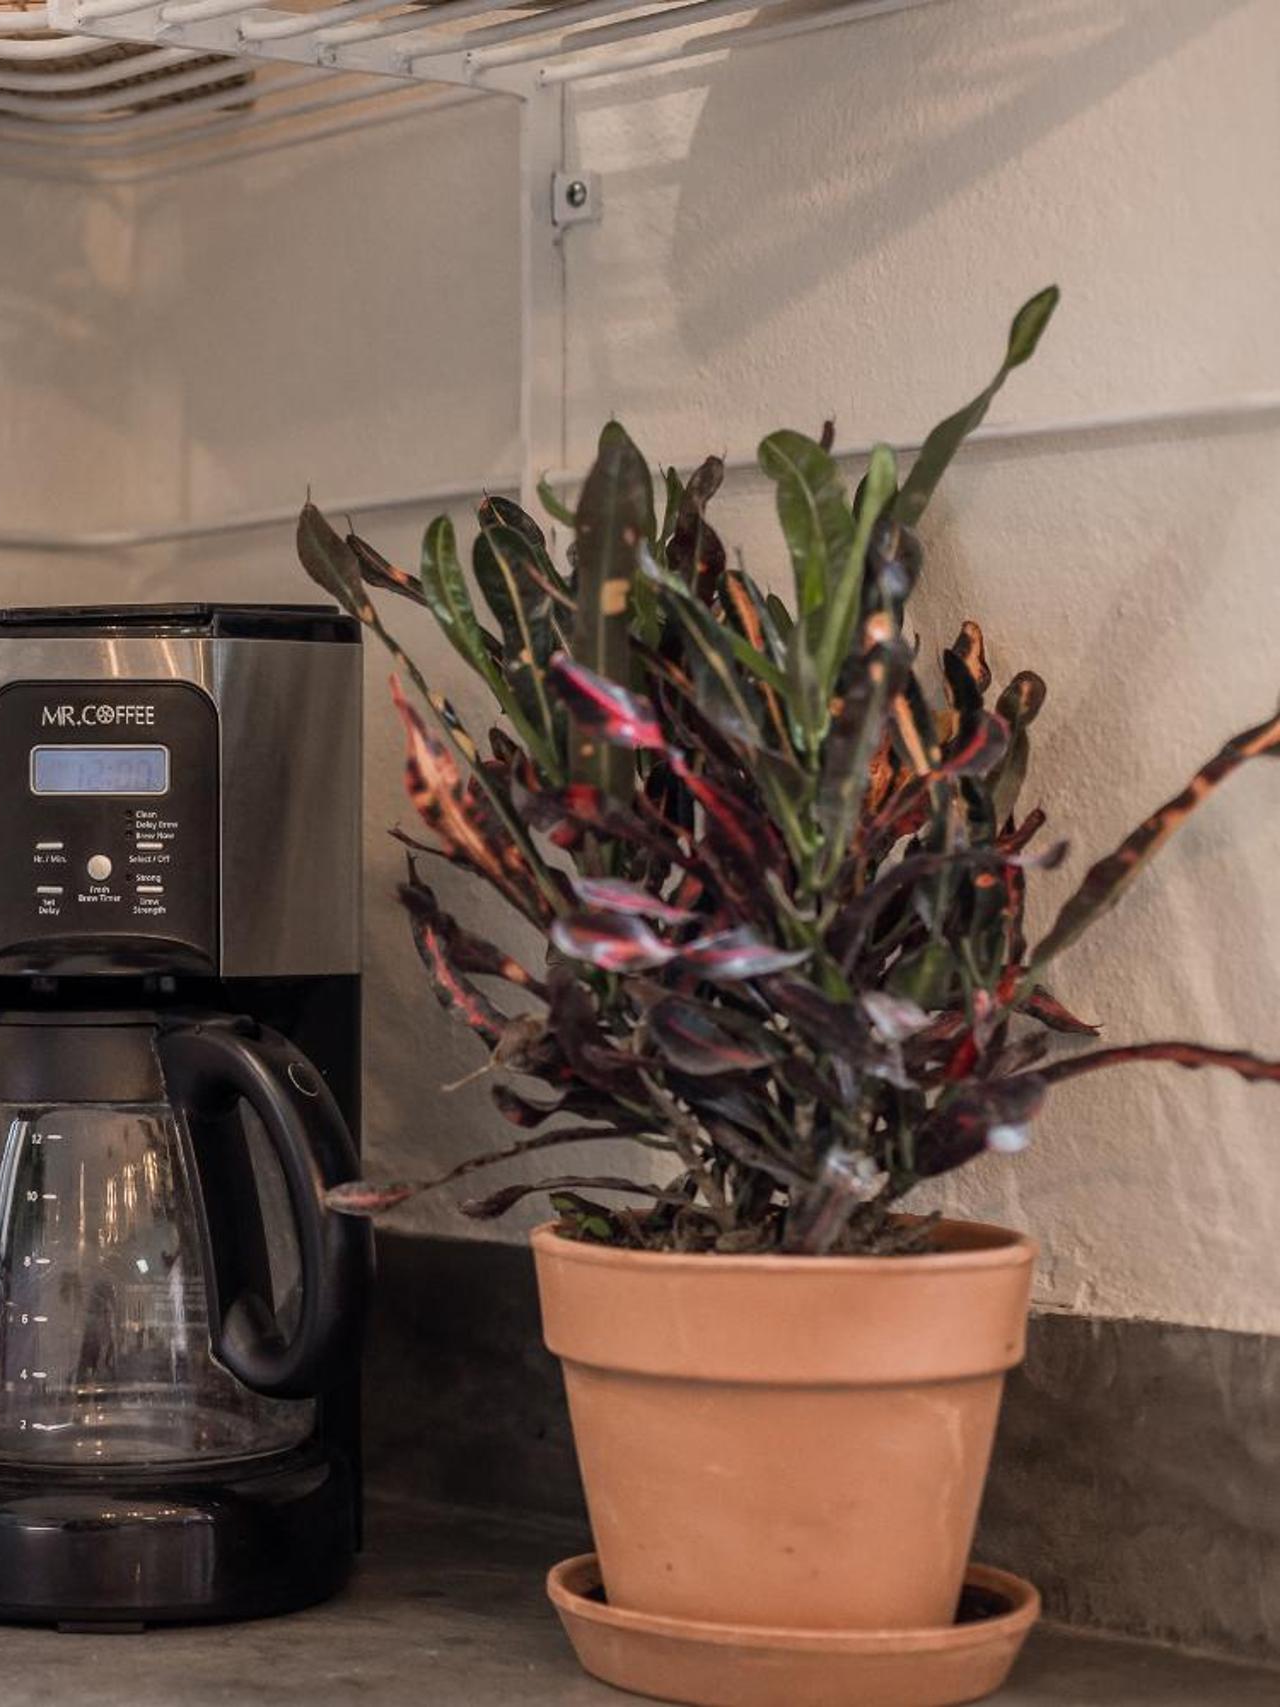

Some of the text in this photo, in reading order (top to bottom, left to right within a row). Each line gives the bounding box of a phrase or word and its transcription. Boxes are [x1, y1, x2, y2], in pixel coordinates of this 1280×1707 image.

[135, 810, 157, 819] Clean
[135, 821, 178, 830] Delay Brew
[129, 854, 151, 864] Select
[135, 874, 161, 884] Strong
[89, 885, 110, 894] Fresh
[43, 899, 56, 907] Set
[38, 905, 61, 916] Delay
[133, 905, 167, 916] Strength
[31, 1133, 42, 1145] 12
[27, 1190, 39, 1202] 10
[23, 1256, 32, 1268] 8
[21, 1313, 29, 1325] 6
[20, 1368, 29, 1380] 4
[19, 1419, 27, 1430] 2
